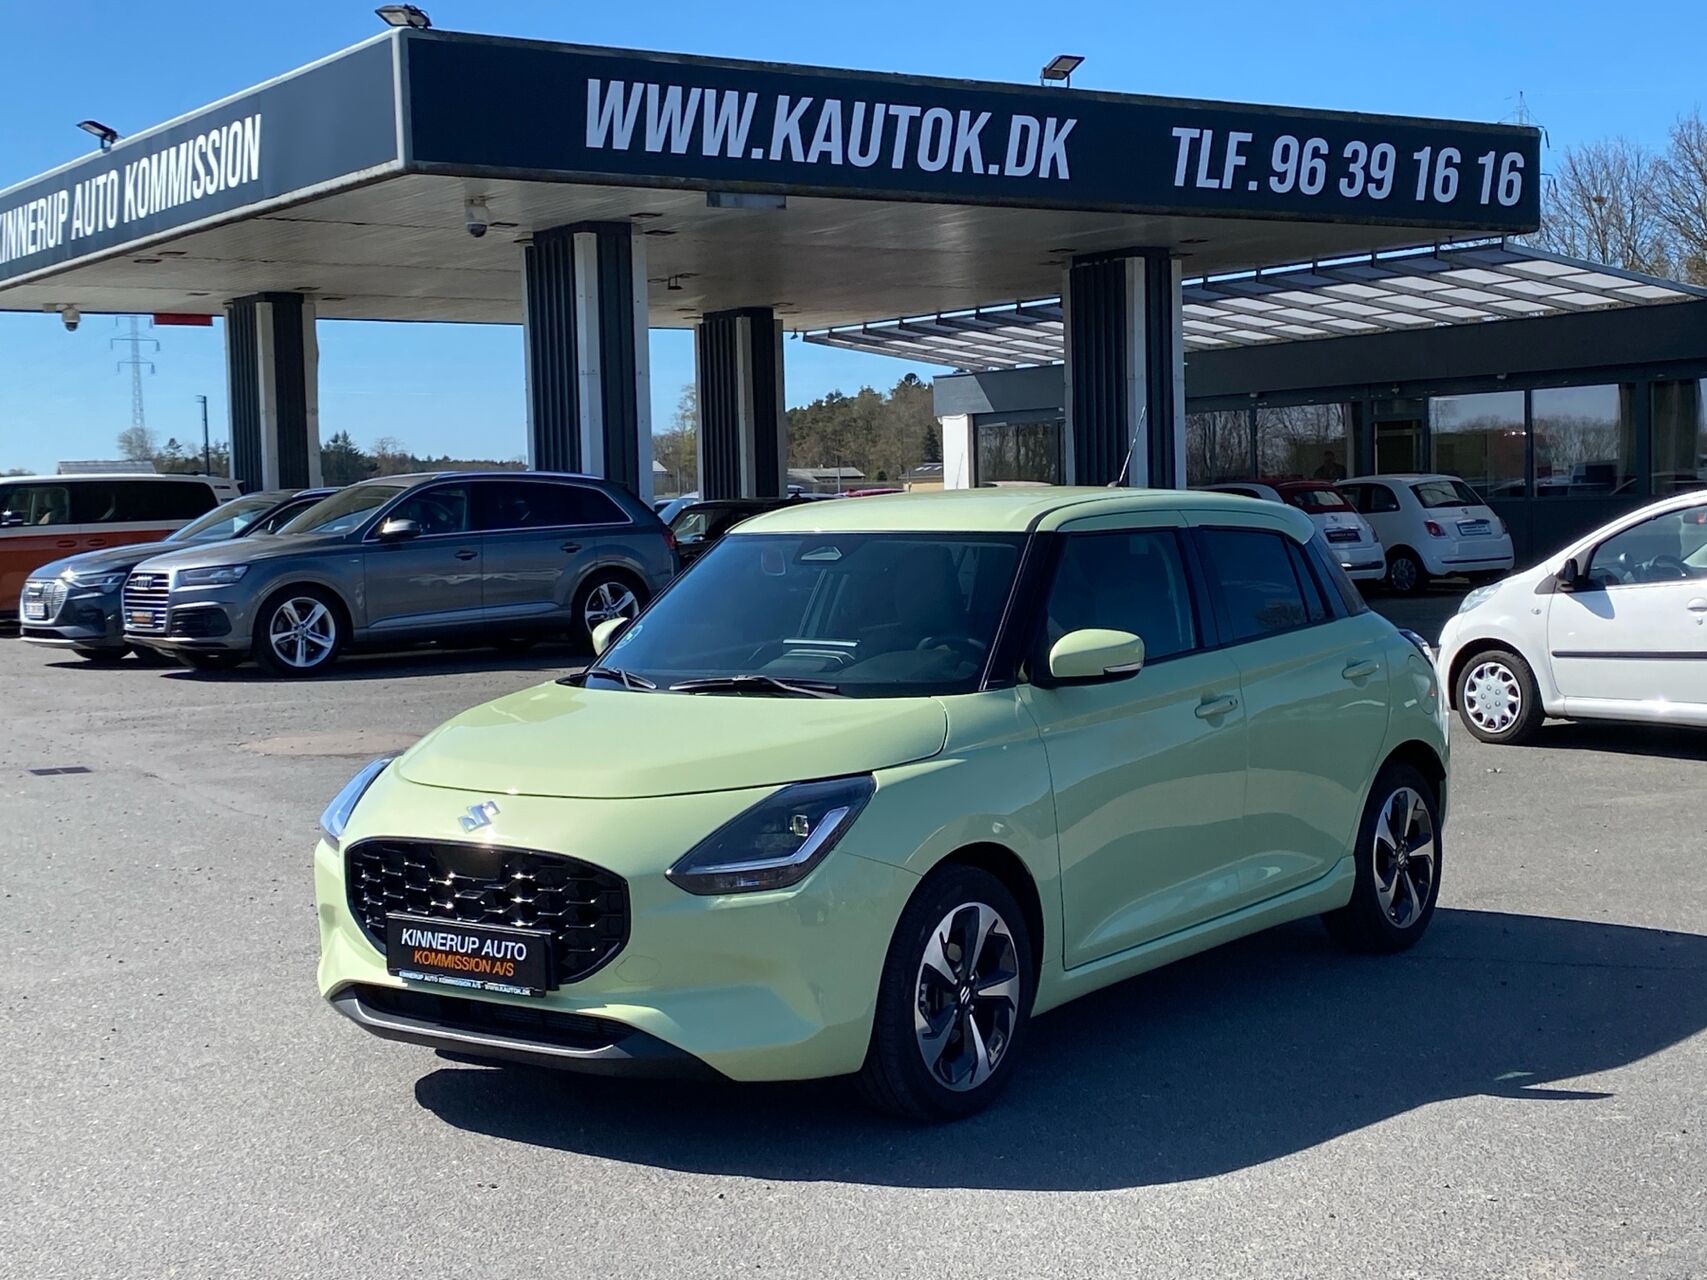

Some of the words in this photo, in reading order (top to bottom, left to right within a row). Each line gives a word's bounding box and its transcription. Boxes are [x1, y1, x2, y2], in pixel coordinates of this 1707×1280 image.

[585, 78, 1077, 180] WWW.KAUTOK.DK
[1171, 126, 1258, 192] TLF.
[1269, 134, 1328, 196] 96
[1339, 140, 1396, 200] 39
[1413, 145, 1460, 203] 16
[1478, 150, 1525, 207] 16
[71, 169, 119, 241] AUTO
[123, 113, 262, 224] KOMMISSION
[401, 928, 479, 954] KINNERUP
[481, 939, 527, 961] AUTO
[414, 950, 491, 973] KOMMISSION
[493, 960, 514, 976] A/S
